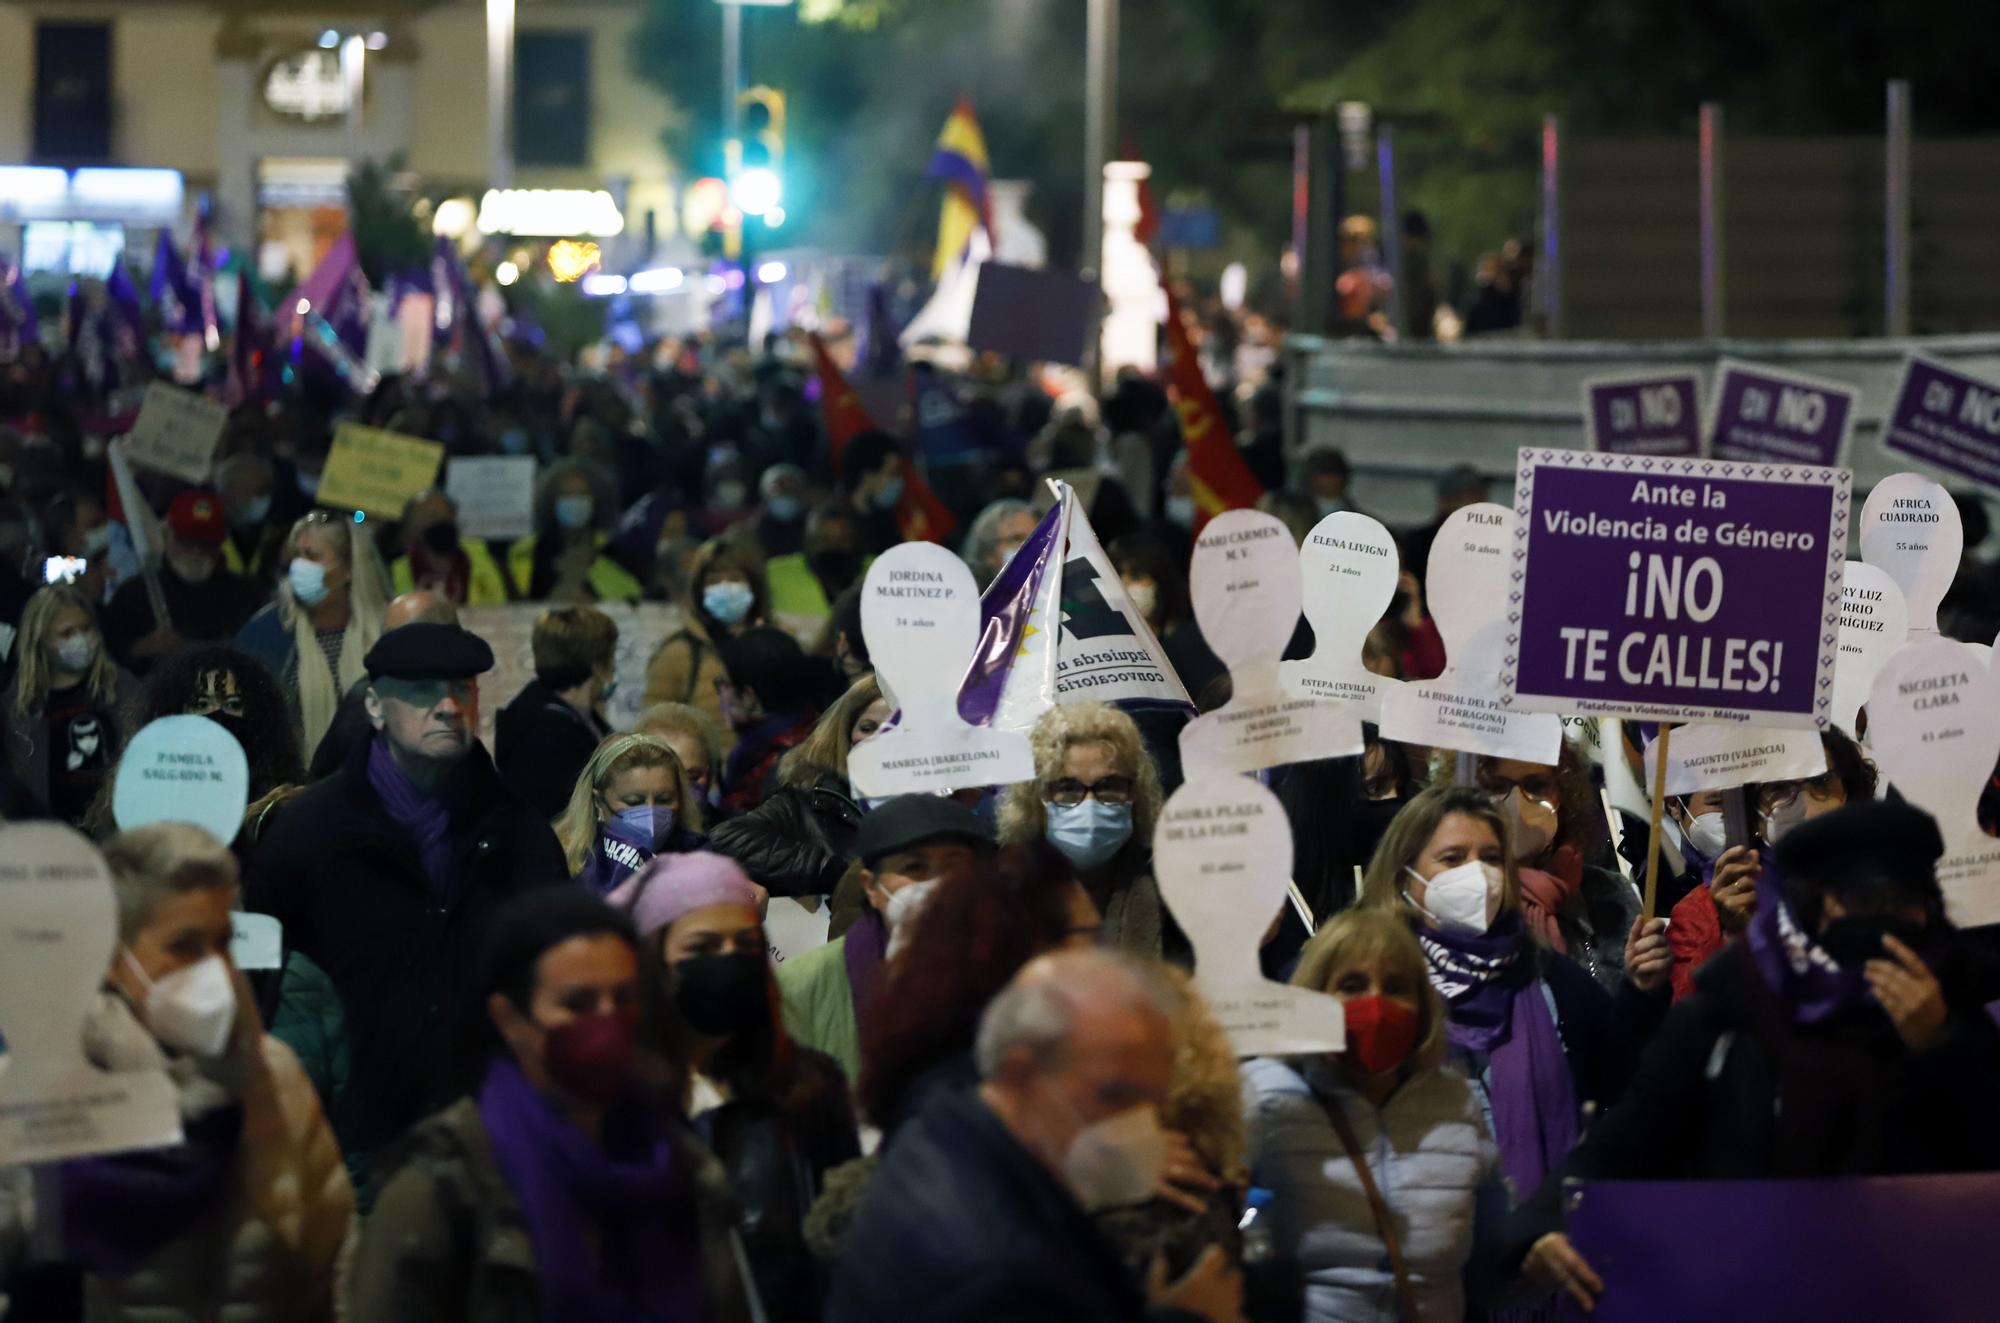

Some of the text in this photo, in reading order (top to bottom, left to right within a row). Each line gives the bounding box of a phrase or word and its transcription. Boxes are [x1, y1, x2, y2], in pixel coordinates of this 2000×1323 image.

[1639, 384, 1683, 427] NO
[1775, 386, 1827, 434] NO
[1631, 480, 1727, 508] Ante la
[1893, 499, 1931, 509] AFRICA
[1467, 511, 1503, 526] PILAR
[1880, 512, 1940, 523] CUADRADO
[1198, 527, 1280, 549] MARI CARMEN
[1543, 510, 1815, 551] Violencia de Género
[1313, 535, 1388, 557] ELENA LIVIGNI
[1464, 542, 1500, 555] 50 años
[1896, 542, 1929, 551] 55 años
[889, 570, 944, 582] JORDINA
[1329, 564, 1362, 577] 21 años
[1625, 551, 1724, 623] ¡NO
[1841, 586, 1883, 601] RY LUZ
[1841, 602, 1874, 615] RRIO
[912, 618, 935, 627] años
[1839, 614, 1884, 632] RÍGUEZ
[1560, 627, 1784, 694] TE CALLES!
[1302, 678, 1375, 694] ESTEPA (SEVILLA)
[1899, 672, 1969, 695] NICOLETA
[1418, 689, 1430, 699] LA
[1432, 692, 1466, 706] BISBAL
[1467, 697, 1486, 709] DEL
[1913, 692, 1960, 711] CLARA
[1438, 705, 1507, 726] (TARRAGONA)
[1576, 700, 1632, 713] Plataforma
[1634, 702, 1680, 716] Violencia
[1682, 707, 1706, 718] Cero
[1713, 709, 1750, 722] Málaga
[157, 752, 214, 765] PAMELA
[881, 750, 1000, 770] MANRESA (BARCELONA)
[1683, 743, 1786, 768] SAGUNTO (VALENCIA)
[1740, 761, 1749, 769] de
[1750, 758, 1768, 768] 2021
[143, 769, 206, 781] SALGADO
